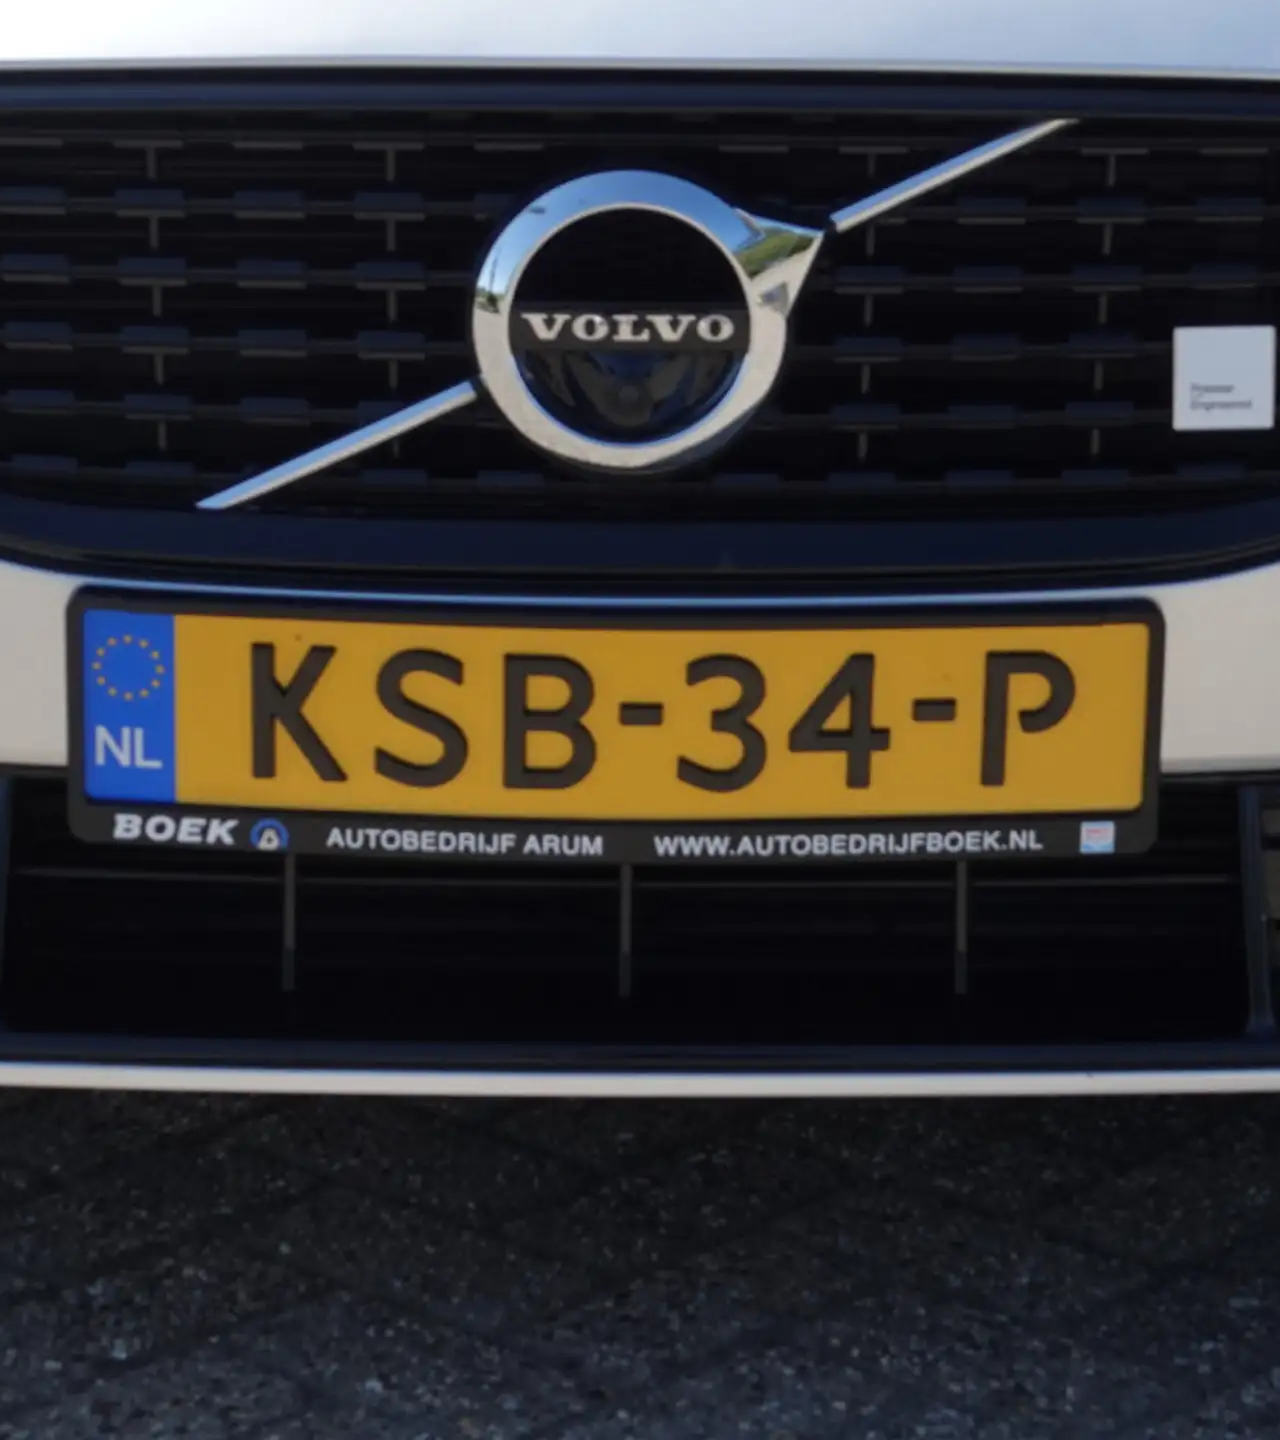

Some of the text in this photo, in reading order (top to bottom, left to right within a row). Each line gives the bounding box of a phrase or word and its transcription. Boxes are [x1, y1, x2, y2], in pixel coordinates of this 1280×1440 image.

[521, 313, 735, 342] VOLVO
[250, 641, 1077, 794] KSB-34-P
[94, 725, 163, 769] NL
[112, 813, 239, 846] BOEK
[325, 826, 604, 856] AUTOBEDRIJF ARUM
[654, 830, 1043, 857] WWW.AUTOBEDRIJFBOEK.NL
